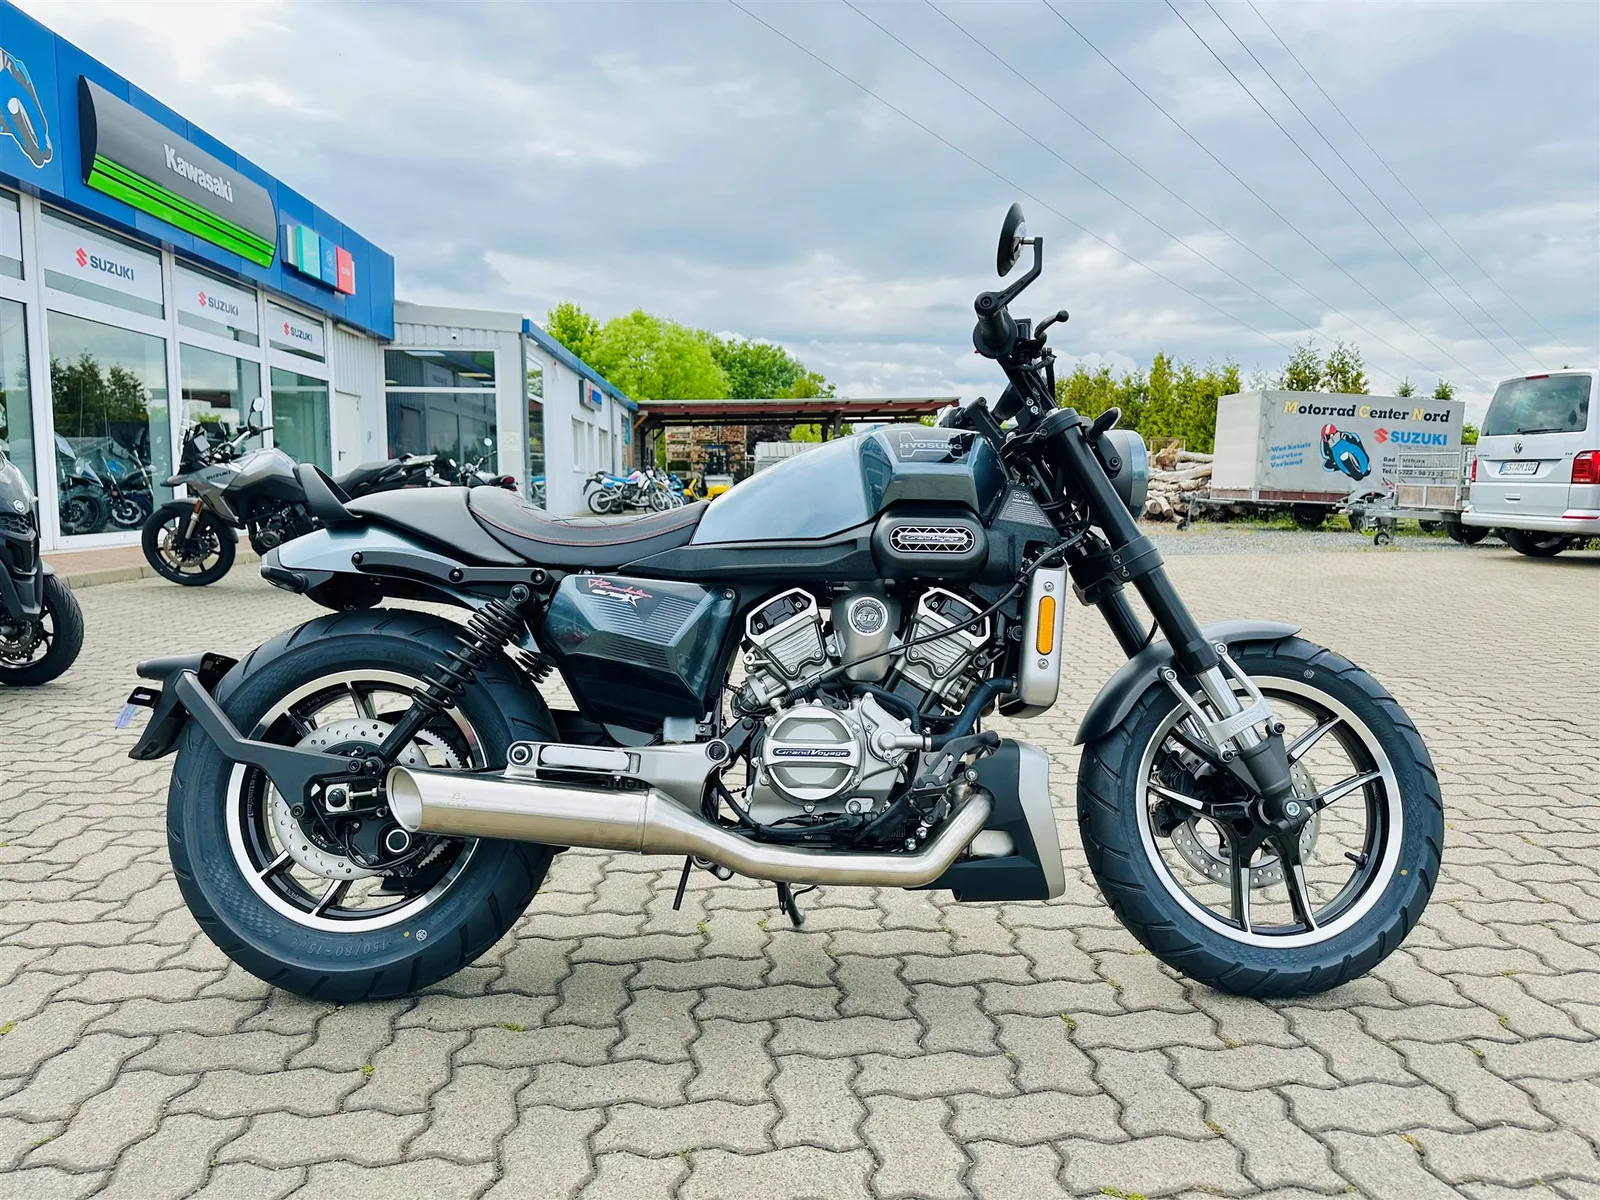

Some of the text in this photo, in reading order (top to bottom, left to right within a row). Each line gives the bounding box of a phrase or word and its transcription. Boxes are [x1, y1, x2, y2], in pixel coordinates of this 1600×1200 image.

[163, 144, 235, 203] Kawasaki
[89, 255, 135, 282] SUZUKI
[207, 297, 239, 317] SUZUKI
[290, 326, 313, 343] SUZUKI
[1282, 400, 1451, 423] Motorrad Center Nord
[900, 442, 963, 450] HYOSUNG
[1390, 430, 1448, 446] SUZUKI
[1271, 442, 1311, 452] Werkstatt
[1271, 452, 1303, 460] Service
[1271, 458, 1303, 468] Verkauf
